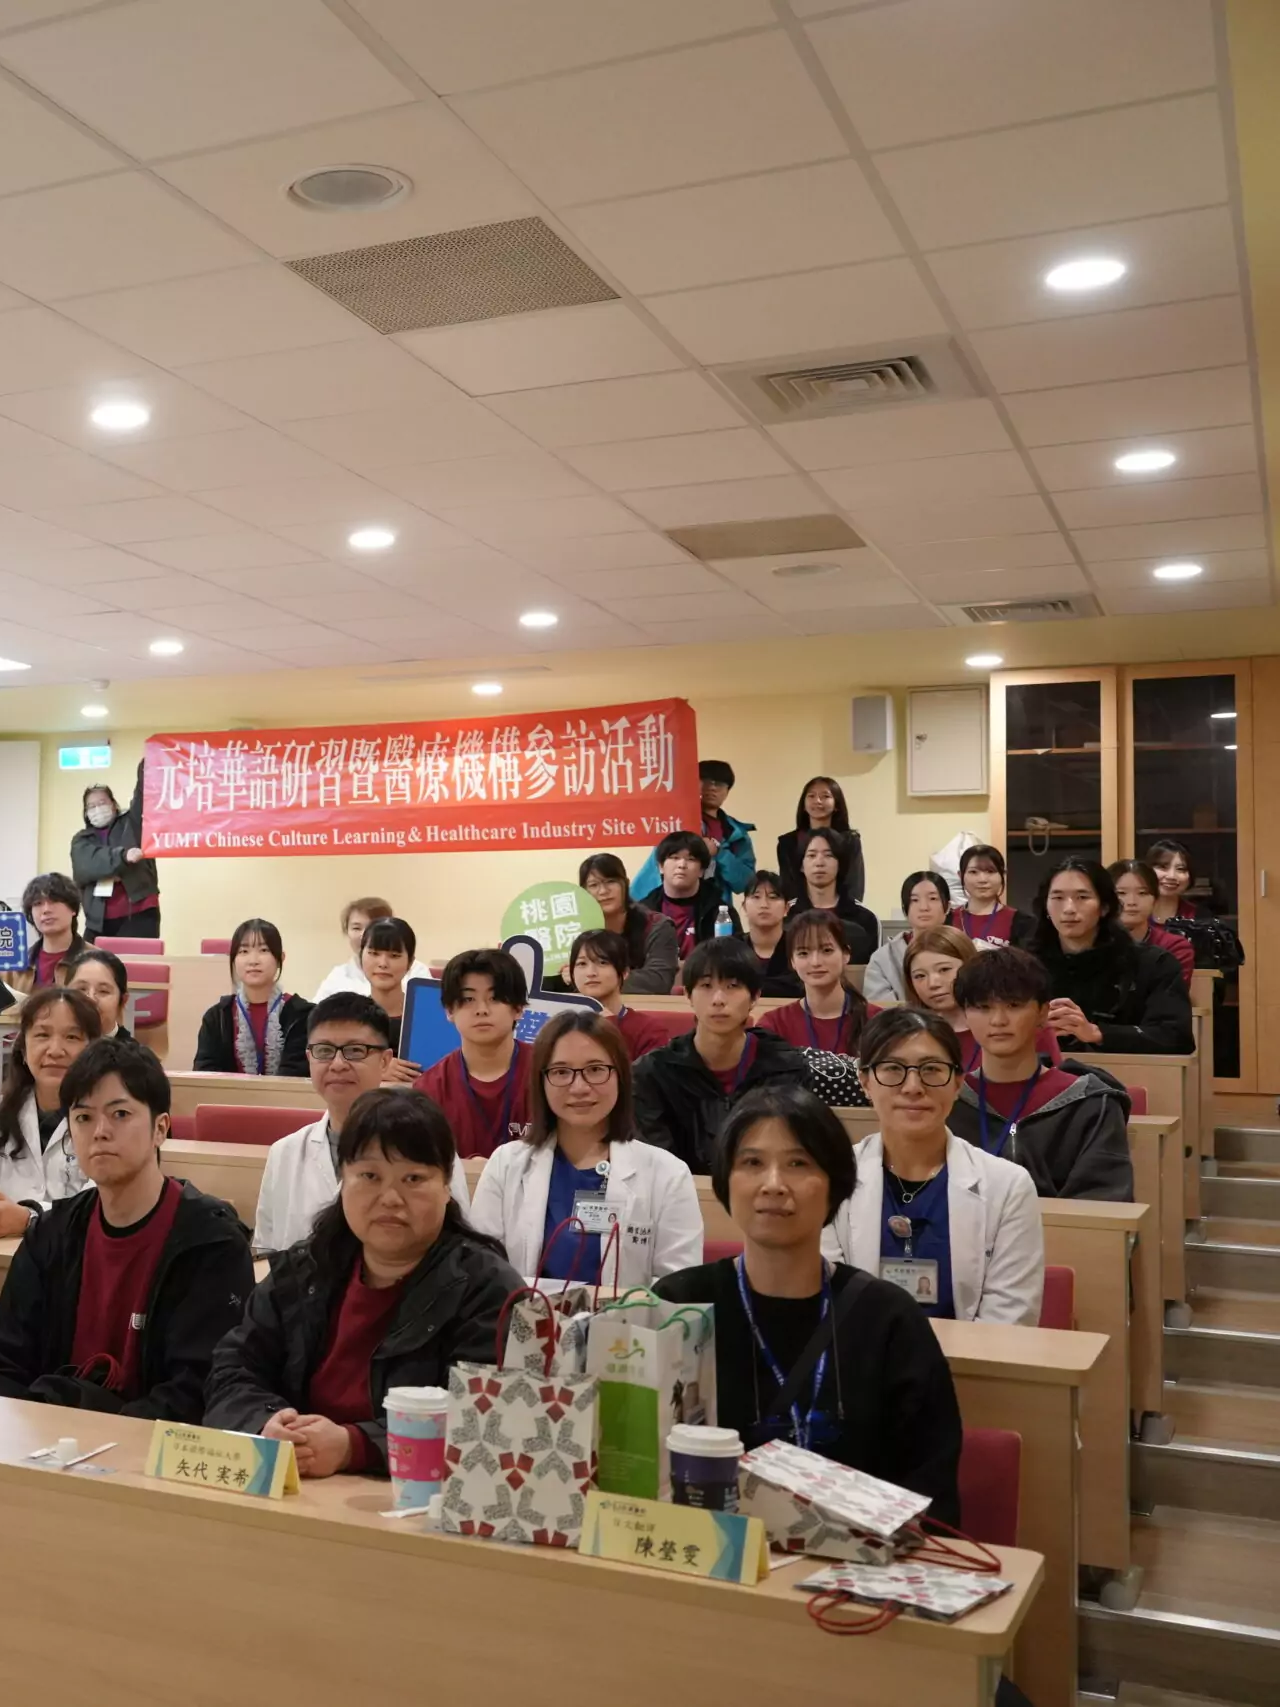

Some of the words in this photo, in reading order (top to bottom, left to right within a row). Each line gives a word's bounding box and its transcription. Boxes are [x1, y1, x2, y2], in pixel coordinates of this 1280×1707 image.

[154, 713, 674, 812] 元培華語研習暨醫療機構參訪活動
[152, 831, 202, 849] YUMT
[205, 829, 264, 848] Chinese
[268, 827, 328, 847] Culture
[333, 825, 406, 847] Learning
[407, 826, 422, 843] &
[426, 823, 517, 843] Healthcare
[522, 820, 596, 841] Industry
[602, 817, 636, 836] Site
[641, 815, 683, 834] Visit
[519, 892, 579, 925] 桃園
[176, 1458, 208, 1481] 矢代
